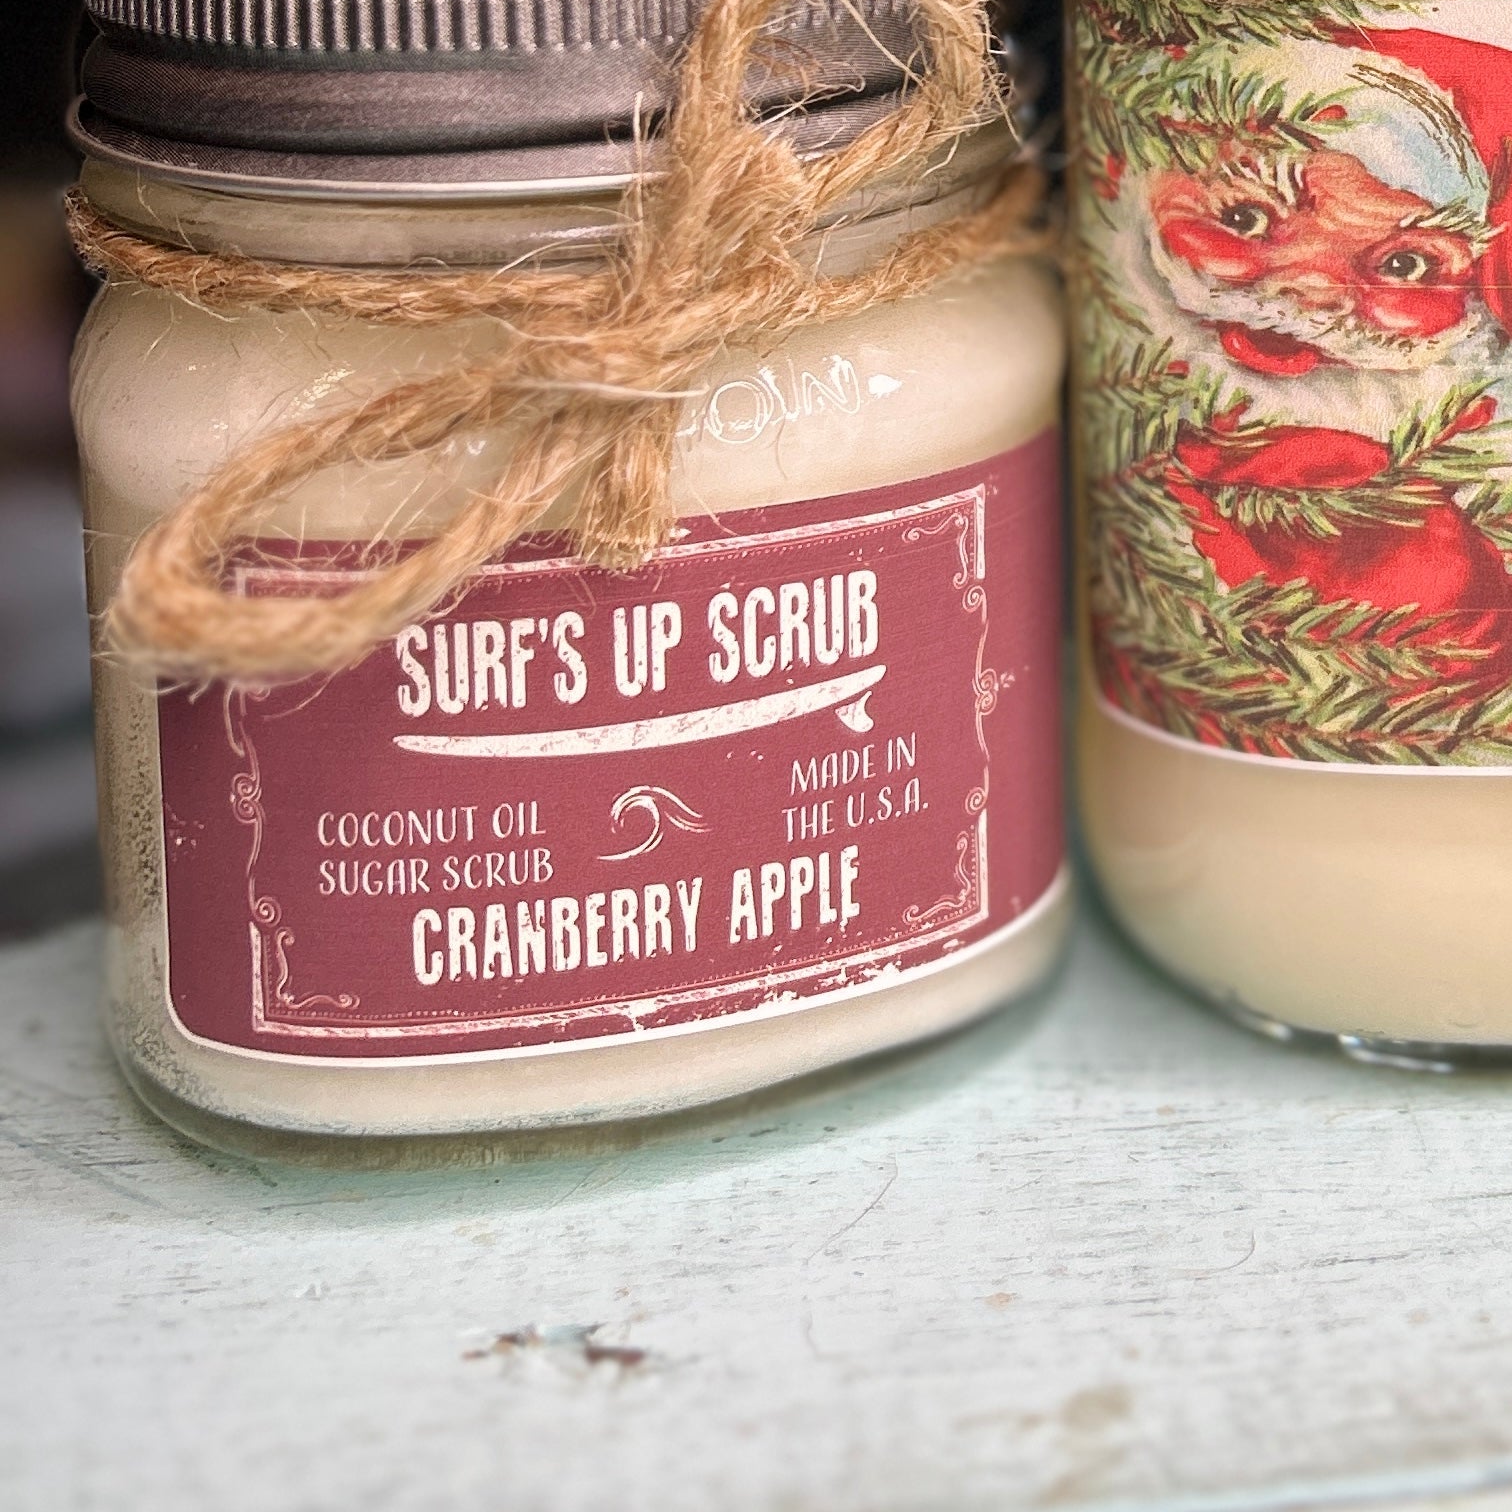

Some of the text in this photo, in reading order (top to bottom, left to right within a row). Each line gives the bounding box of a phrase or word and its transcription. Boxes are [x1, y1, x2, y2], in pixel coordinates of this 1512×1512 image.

[395, 569, 879, 717] SURF'S UP SCRUB
[790, 732, 916, 796] MADE IN
[318, 801, 546, 848] COCONUT OIL
[781, 777, 929, 843] THE U.S.A.
[319, 848, 554, 896] SUGAR SCRUB
[412, 844, 860, 986] CRANBERRY APPLE
